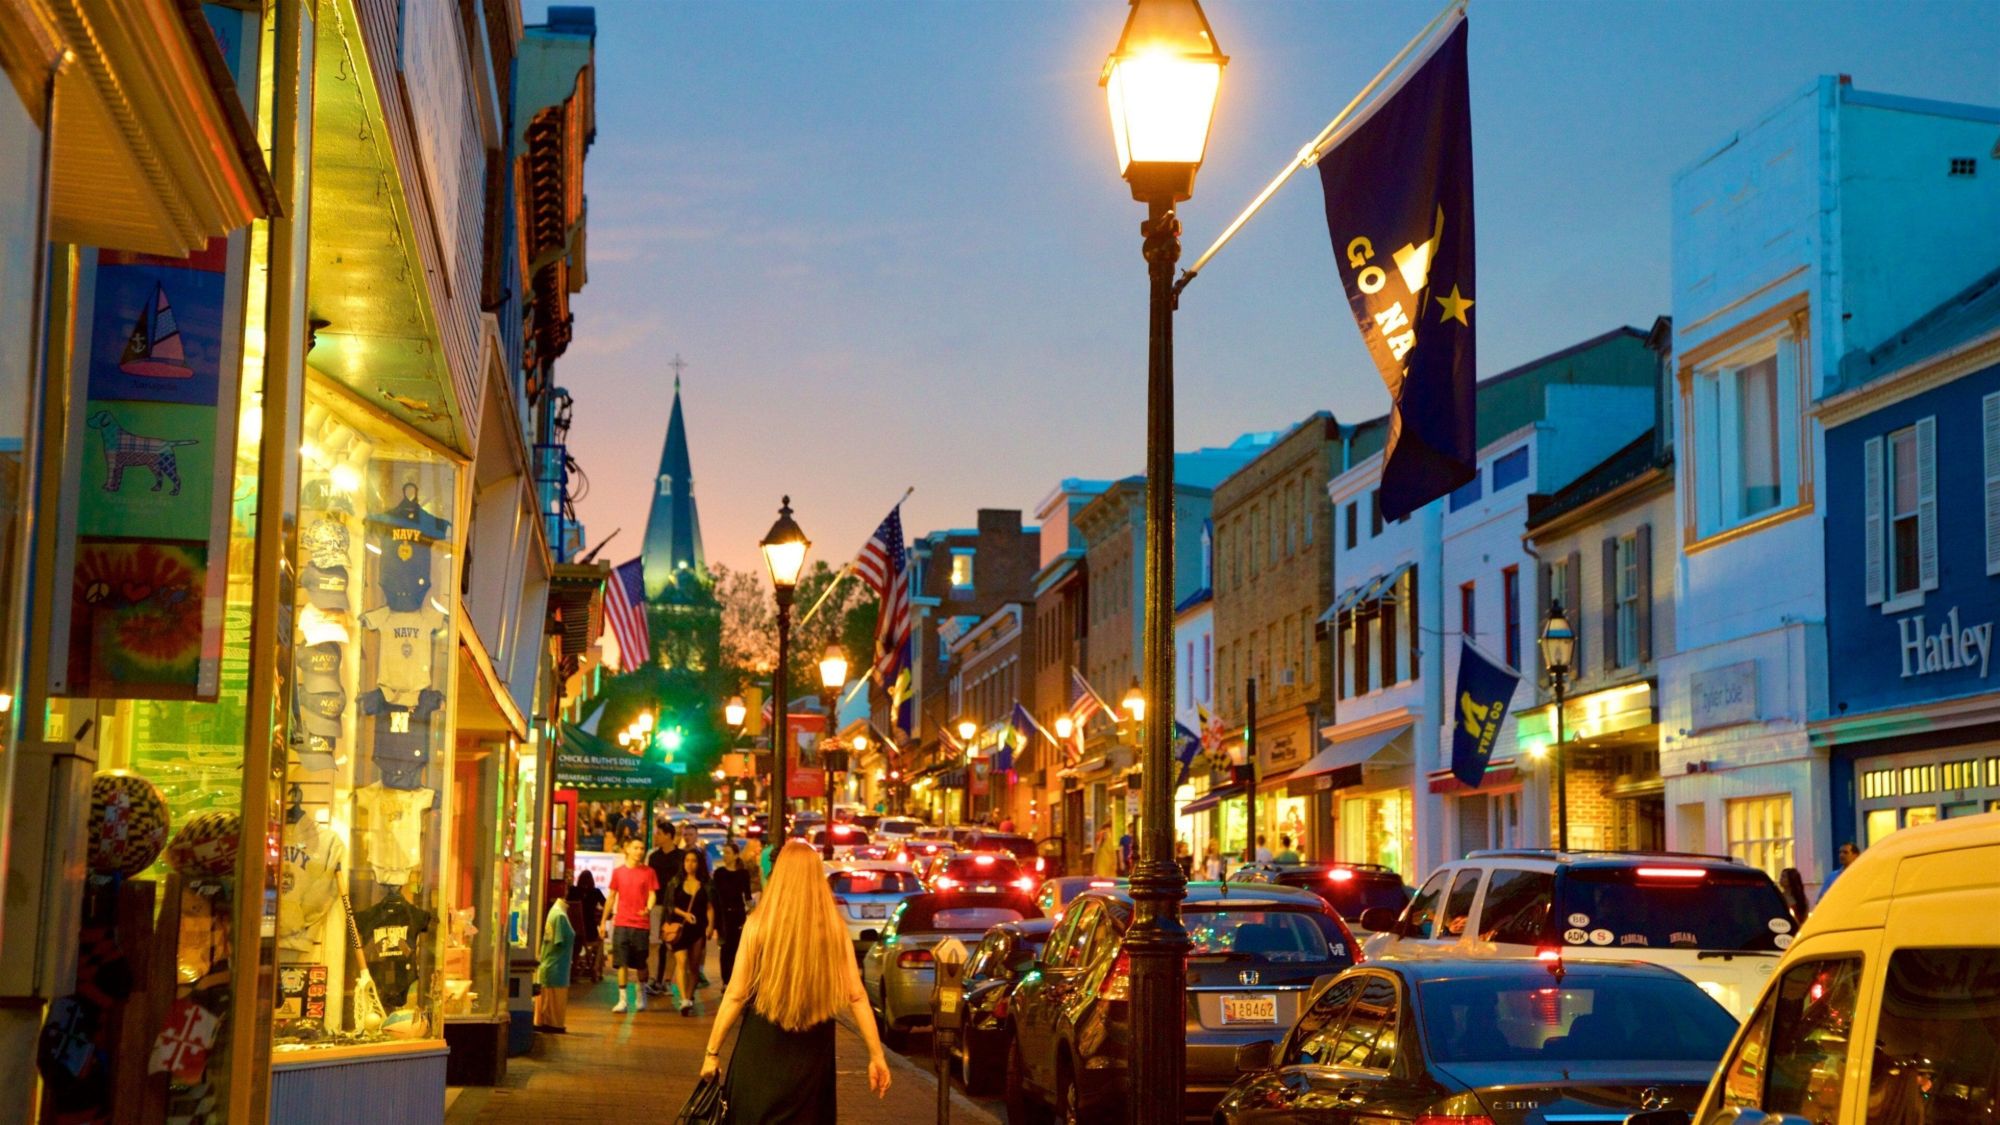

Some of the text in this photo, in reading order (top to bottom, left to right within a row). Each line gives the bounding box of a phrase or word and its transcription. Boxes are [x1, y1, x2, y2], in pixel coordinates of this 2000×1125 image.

[1347, 236, 1386, 294] GO
[1374, 301, 1417, 378] NA
[392, 529, 421, 541] NAVY
[394, 627, 419, 639] NAVY
[1897, 606, 1994, 678] Hatley
[558, 755, 582, 763] CHICK
[591, 756, 617, 765] RUTH'S
[619, 757, 640, 766] DELLY
[557, 773, 592, 782] BREAKFAST
[283, 846, 311, 871] AVY
[1568, 932, 1585, 941] ADK
[1597, 932, 1606, 941] S
